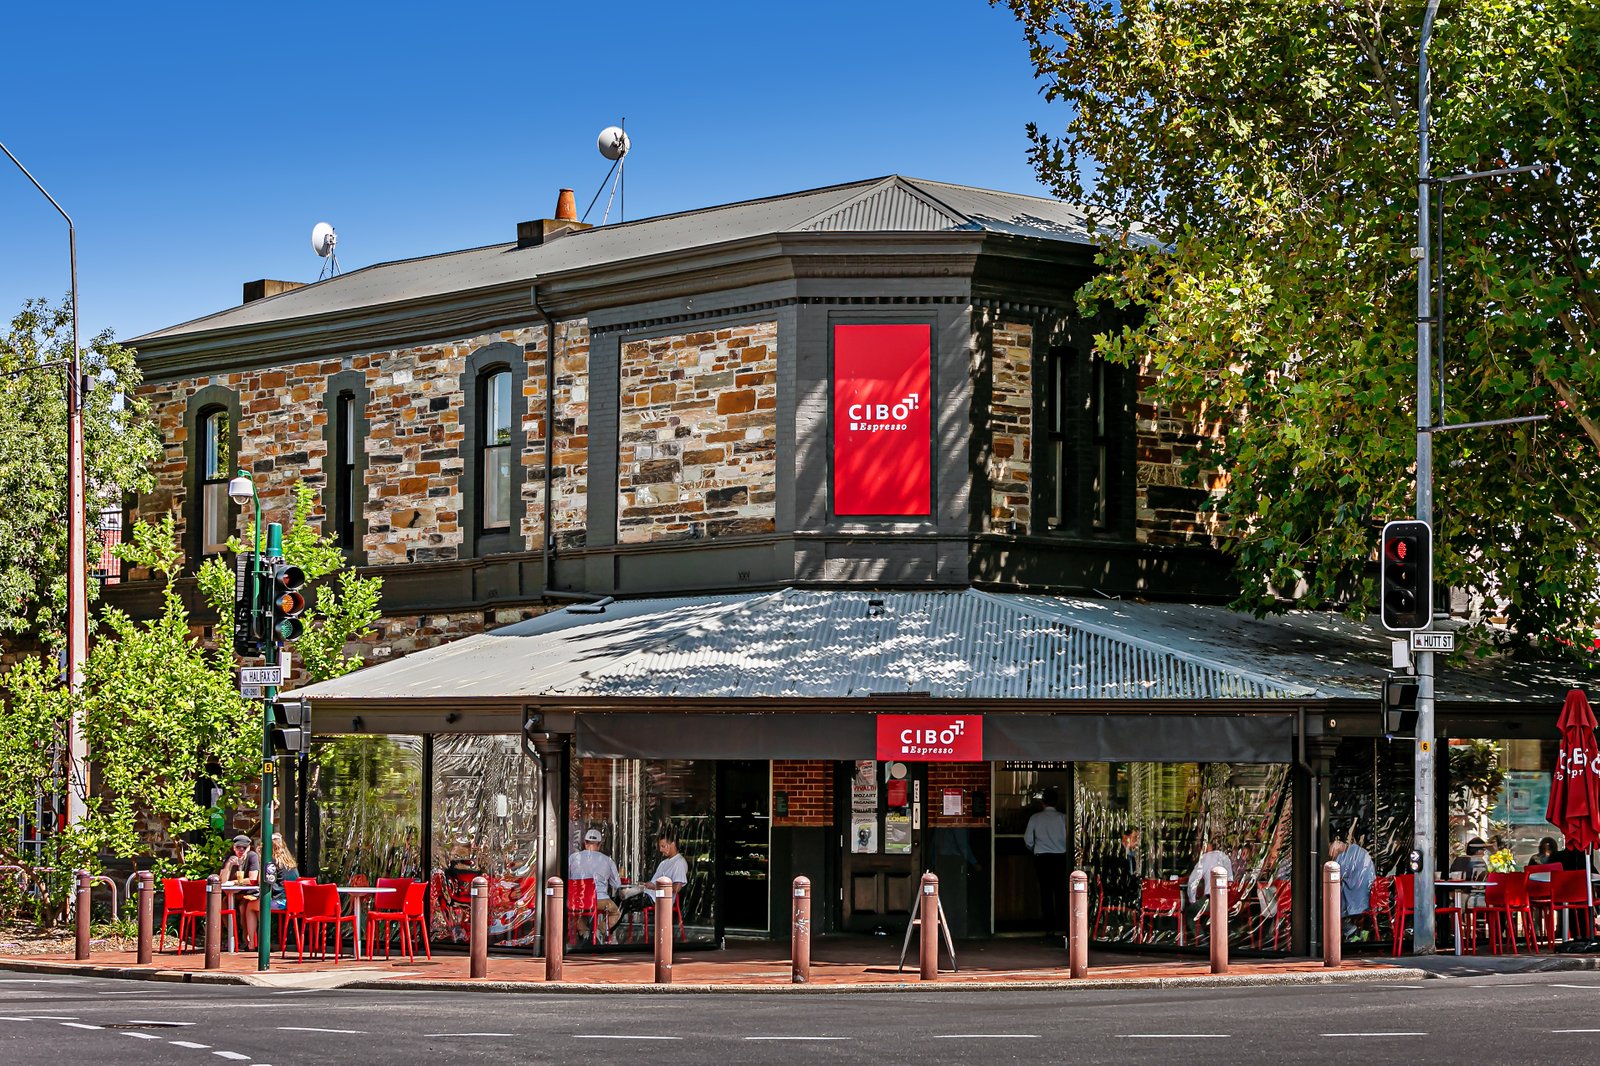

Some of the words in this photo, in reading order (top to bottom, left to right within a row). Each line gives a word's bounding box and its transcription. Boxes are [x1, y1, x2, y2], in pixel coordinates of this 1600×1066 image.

[848, 404, 909, 421] CIBO
[859, 422, 907, 433] Espresso
[1423, 635, 1441, 647] HUTT
[1442, 635, 1452, 647] ST
[249, 670, 271, 682] HALIFAX
[271, 670, 280, 682] ST
[900, 729, 955, 745] CIBO
[909, 746, 954, 756] Espresso
